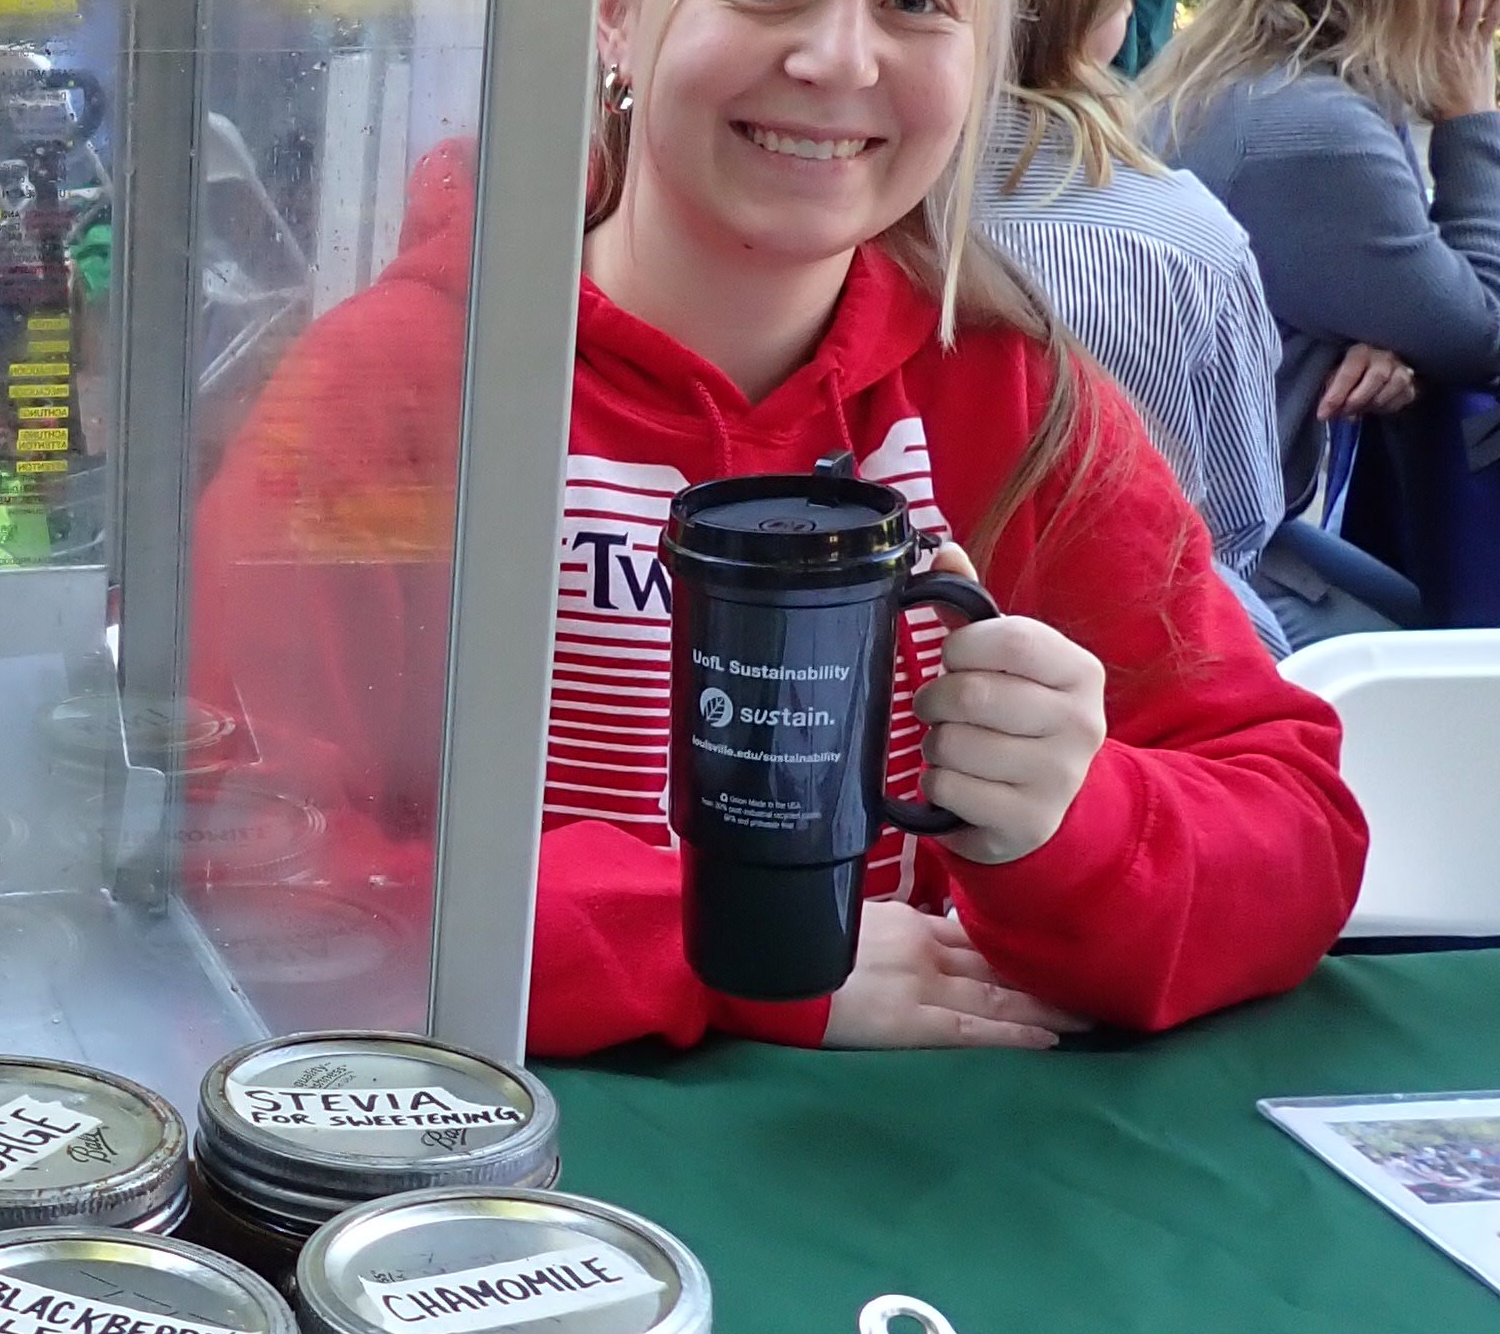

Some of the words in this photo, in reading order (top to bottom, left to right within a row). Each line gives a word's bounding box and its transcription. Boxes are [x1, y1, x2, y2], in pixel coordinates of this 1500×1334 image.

[692, 648, 725, 673] UofL
[729, 660, 850, 682] Sustainability
[691, 733, 842, 763] louisville.edu/sustainability
[245, 1088, 452, 1114] STEVIA
[251, 1111, 315, 1127] FOR
[329, 1106, 521, 1127] SWEETENING
[381, 1257, 624, 1324] CHAMOMILE
